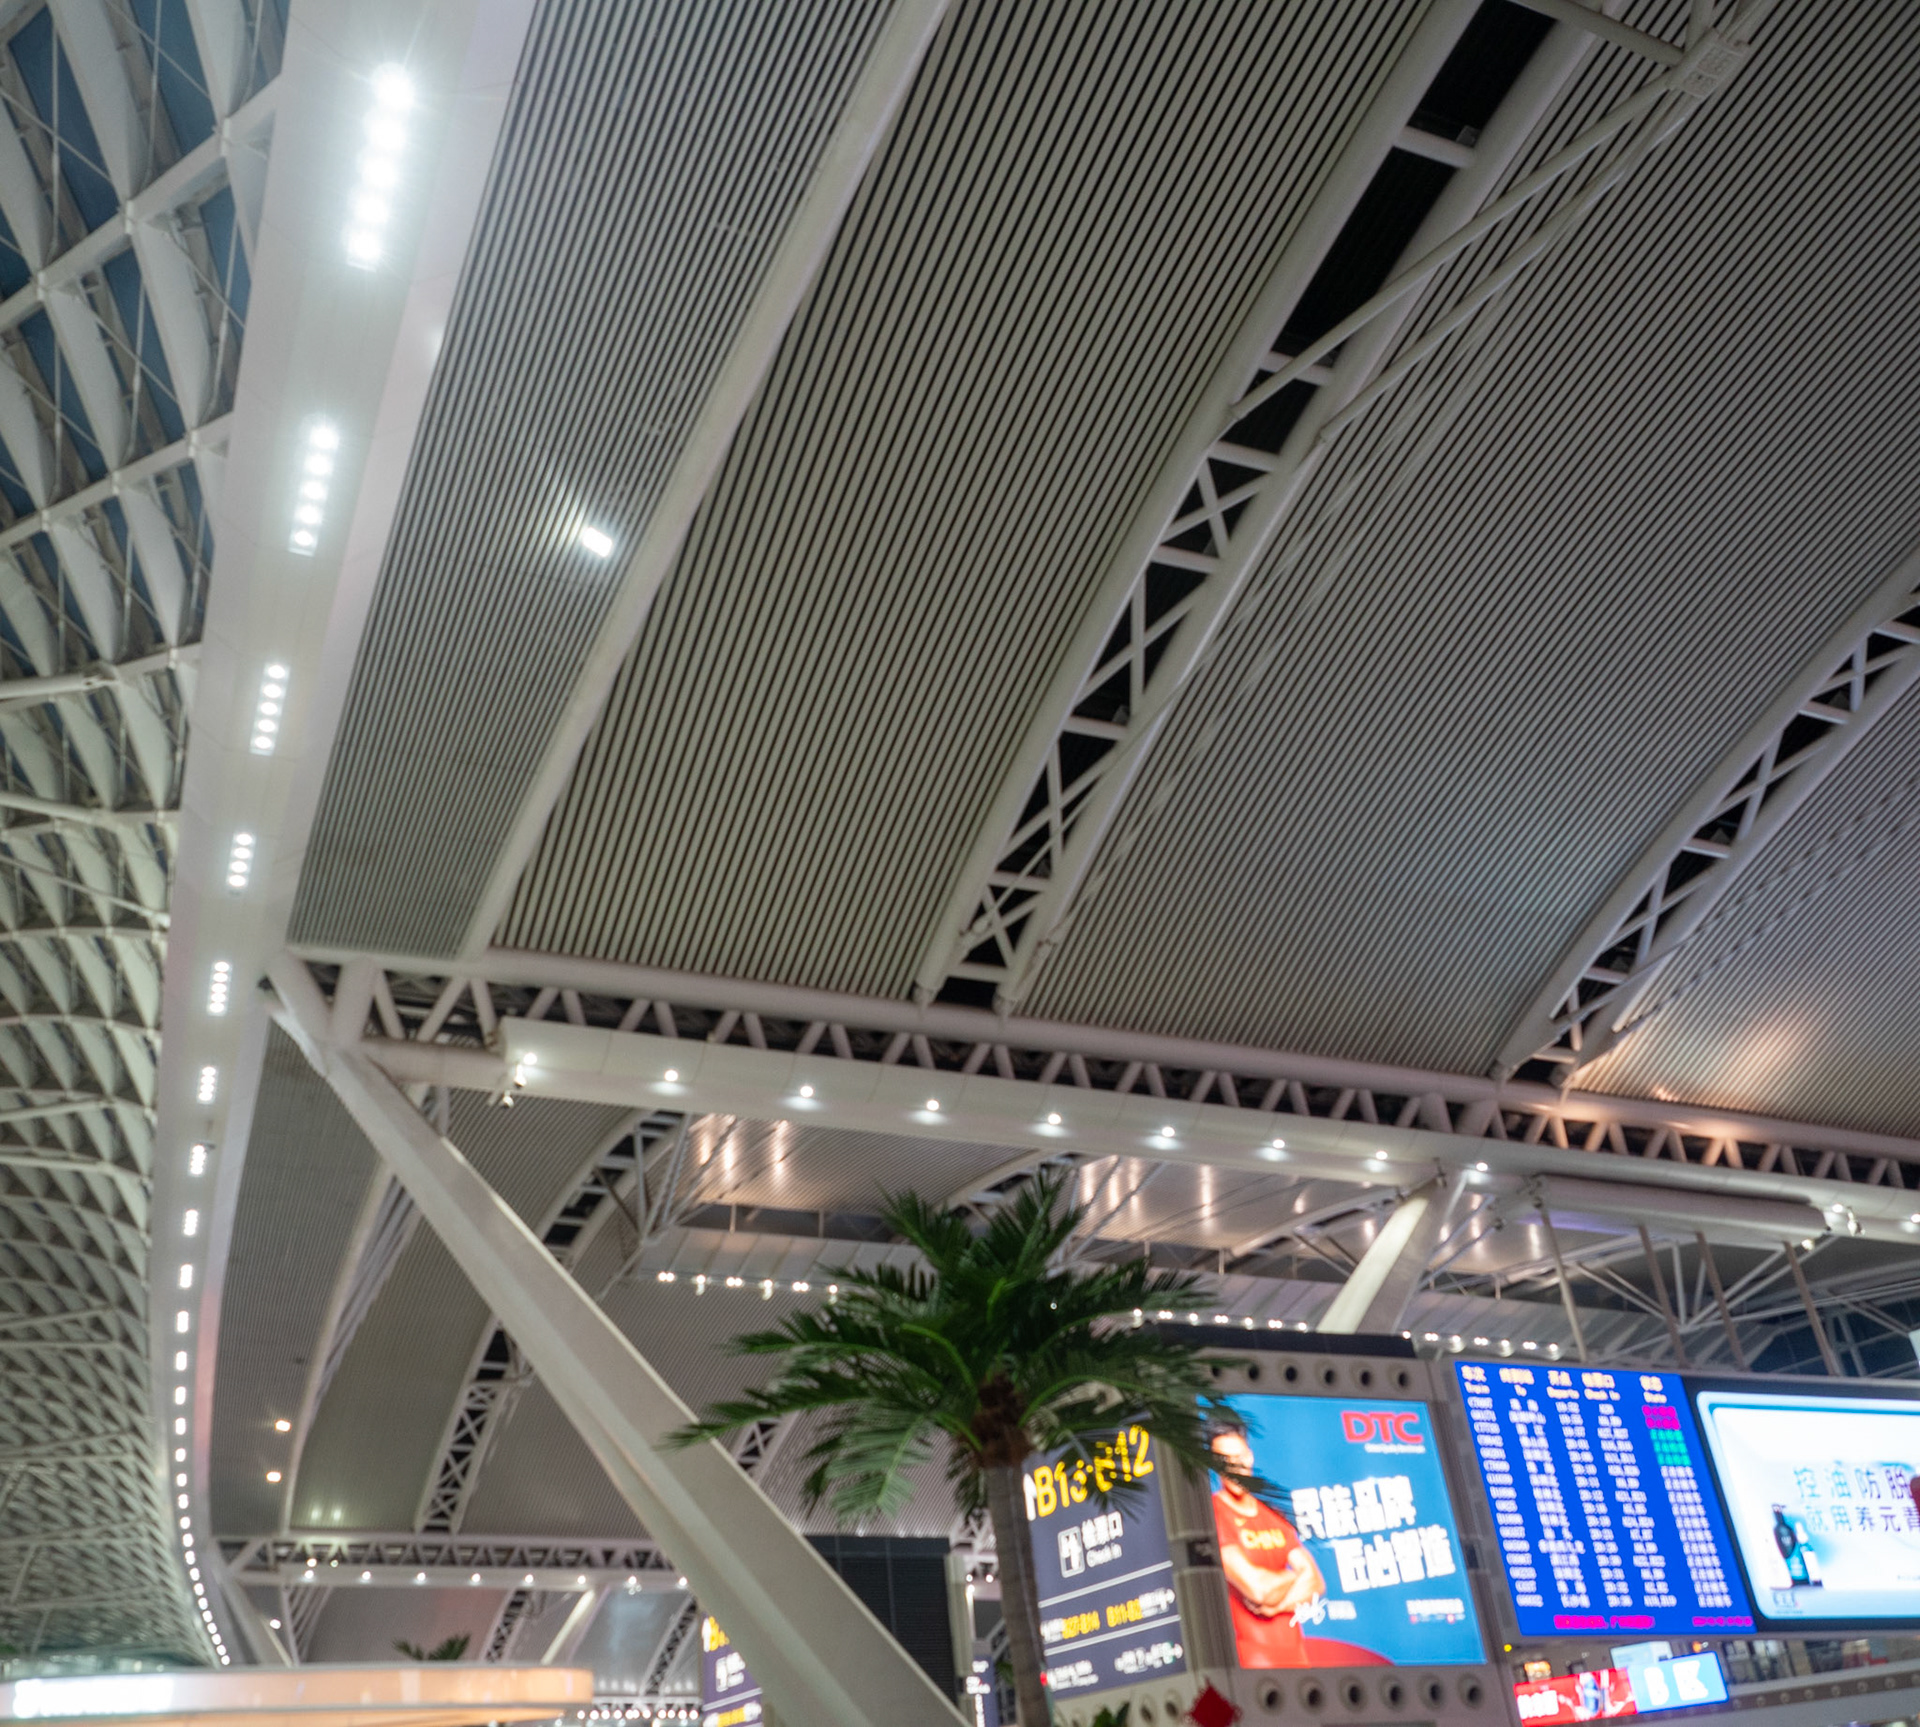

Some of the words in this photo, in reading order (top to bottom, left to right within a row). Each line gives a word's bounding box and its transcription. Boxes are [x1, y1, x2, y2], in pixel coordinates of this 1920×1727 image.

[1341, 1410, 1424, 1444] DTC
[1794, 1461, 1912, 1499] 控油防脱
